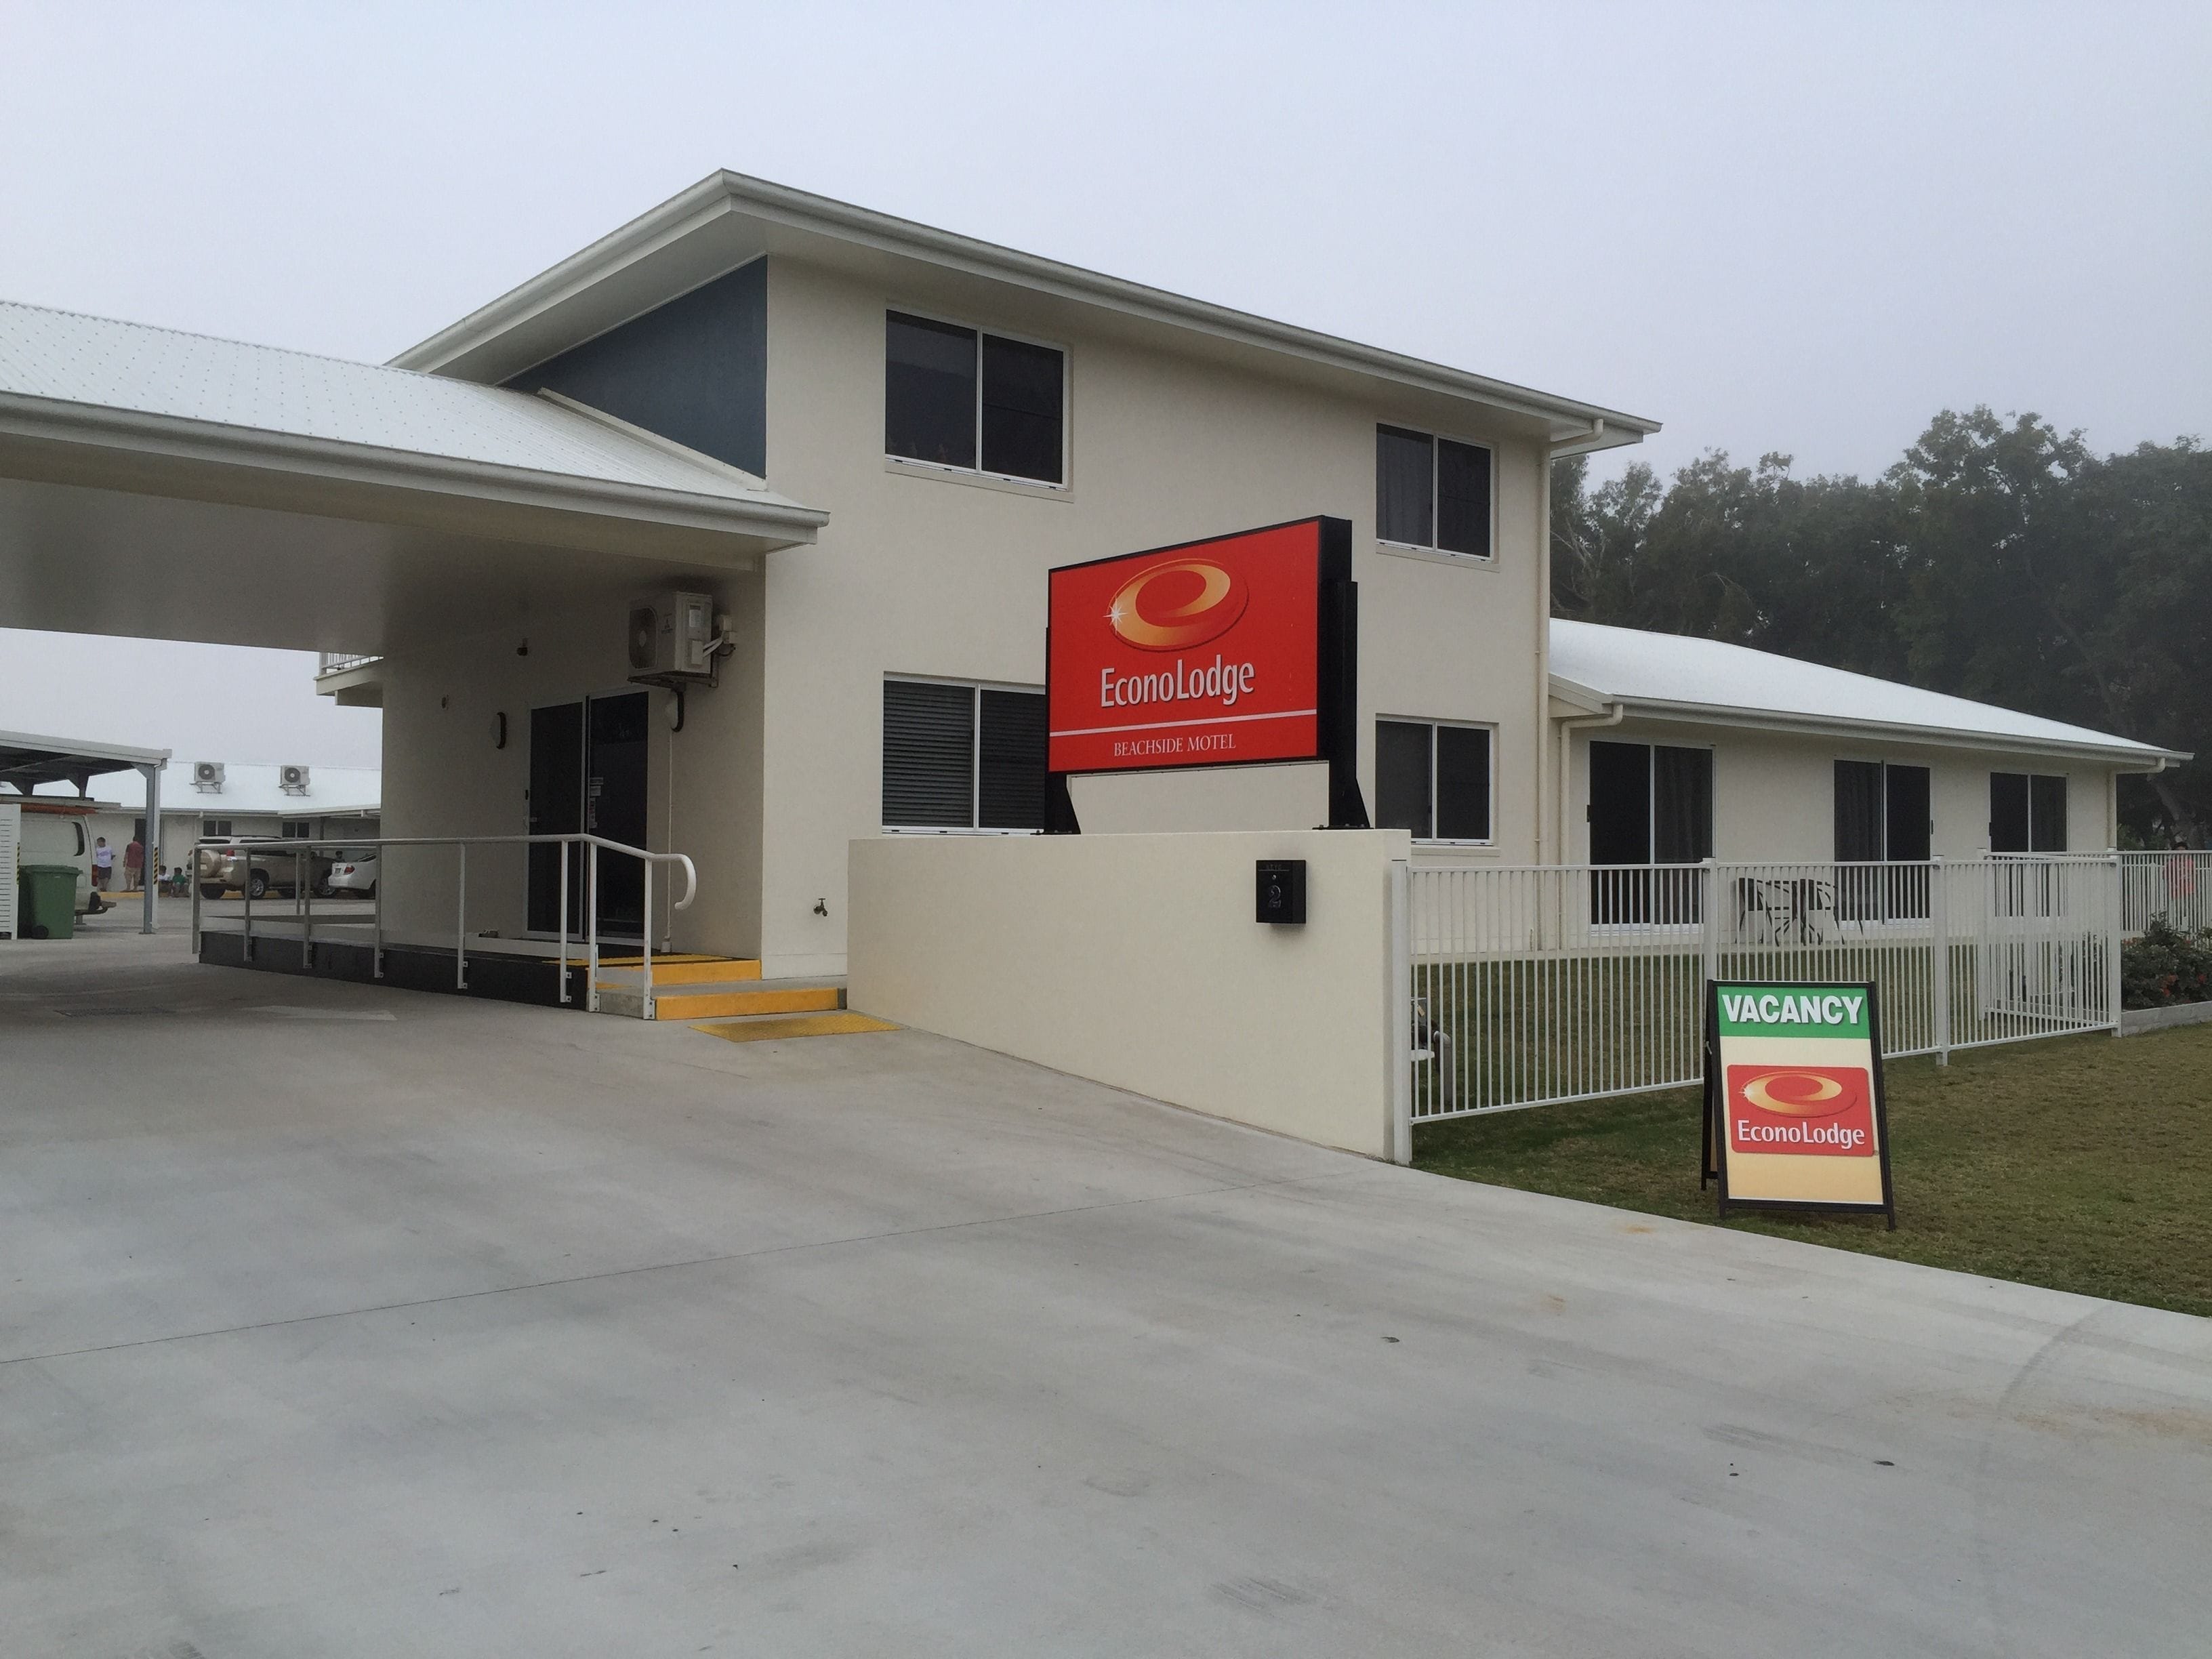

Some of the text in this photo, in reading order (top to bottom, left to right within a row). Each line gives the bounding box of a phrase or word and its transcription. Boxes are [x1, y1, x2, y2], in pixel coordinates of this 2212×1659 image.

[1101, 655, 1255, 708] EconoLodge
[1113, 734, 1237, 757] BEACHSIDE MOTEL
[1721, 994, 1863, 1025] VACANCY
[1737, 1120, 1865, 1149] EconoLodge
